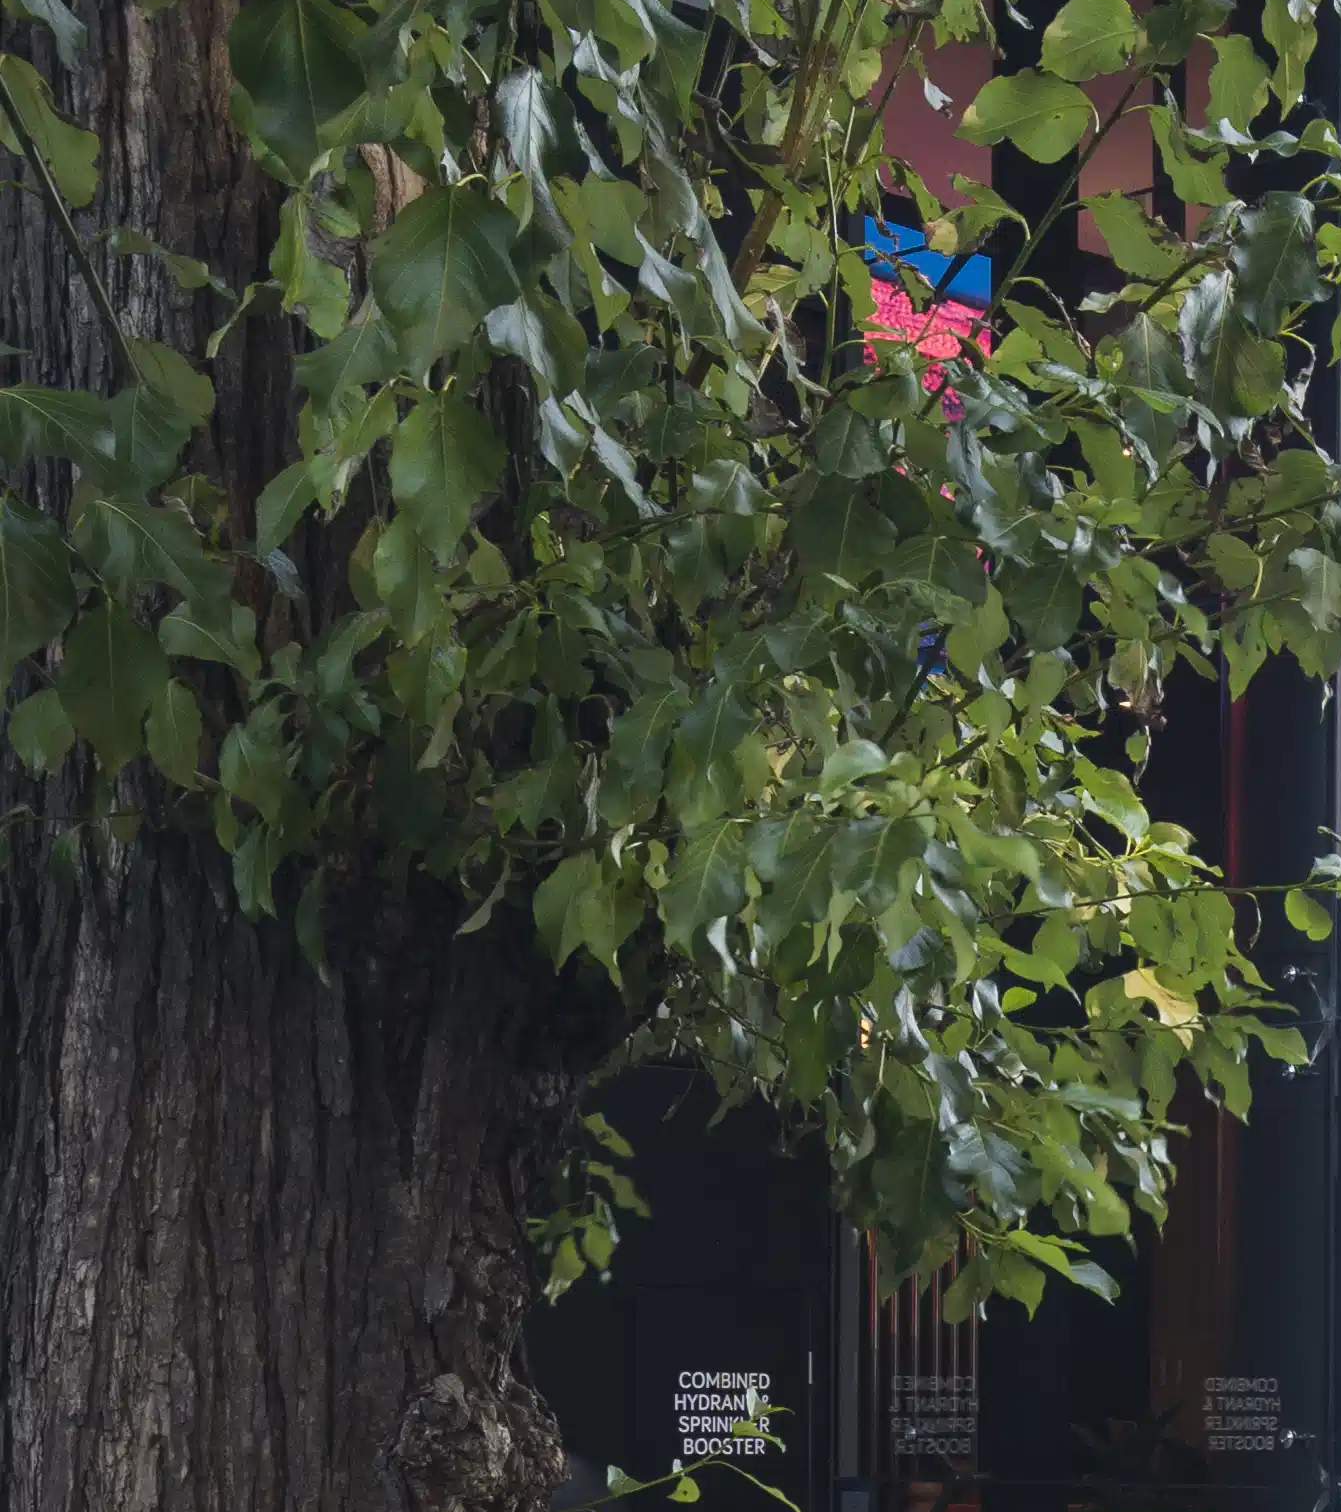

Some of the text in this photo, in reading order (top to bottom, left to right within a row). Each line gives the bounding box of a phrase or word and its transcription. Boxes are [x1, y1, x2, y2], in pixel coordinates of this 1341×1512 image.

[678, 1371, 771, 1389] COMBINED
[674, 1393, 757, 1411] HYDRAN
[683, 1437, 766, 1455] BOOSTER
